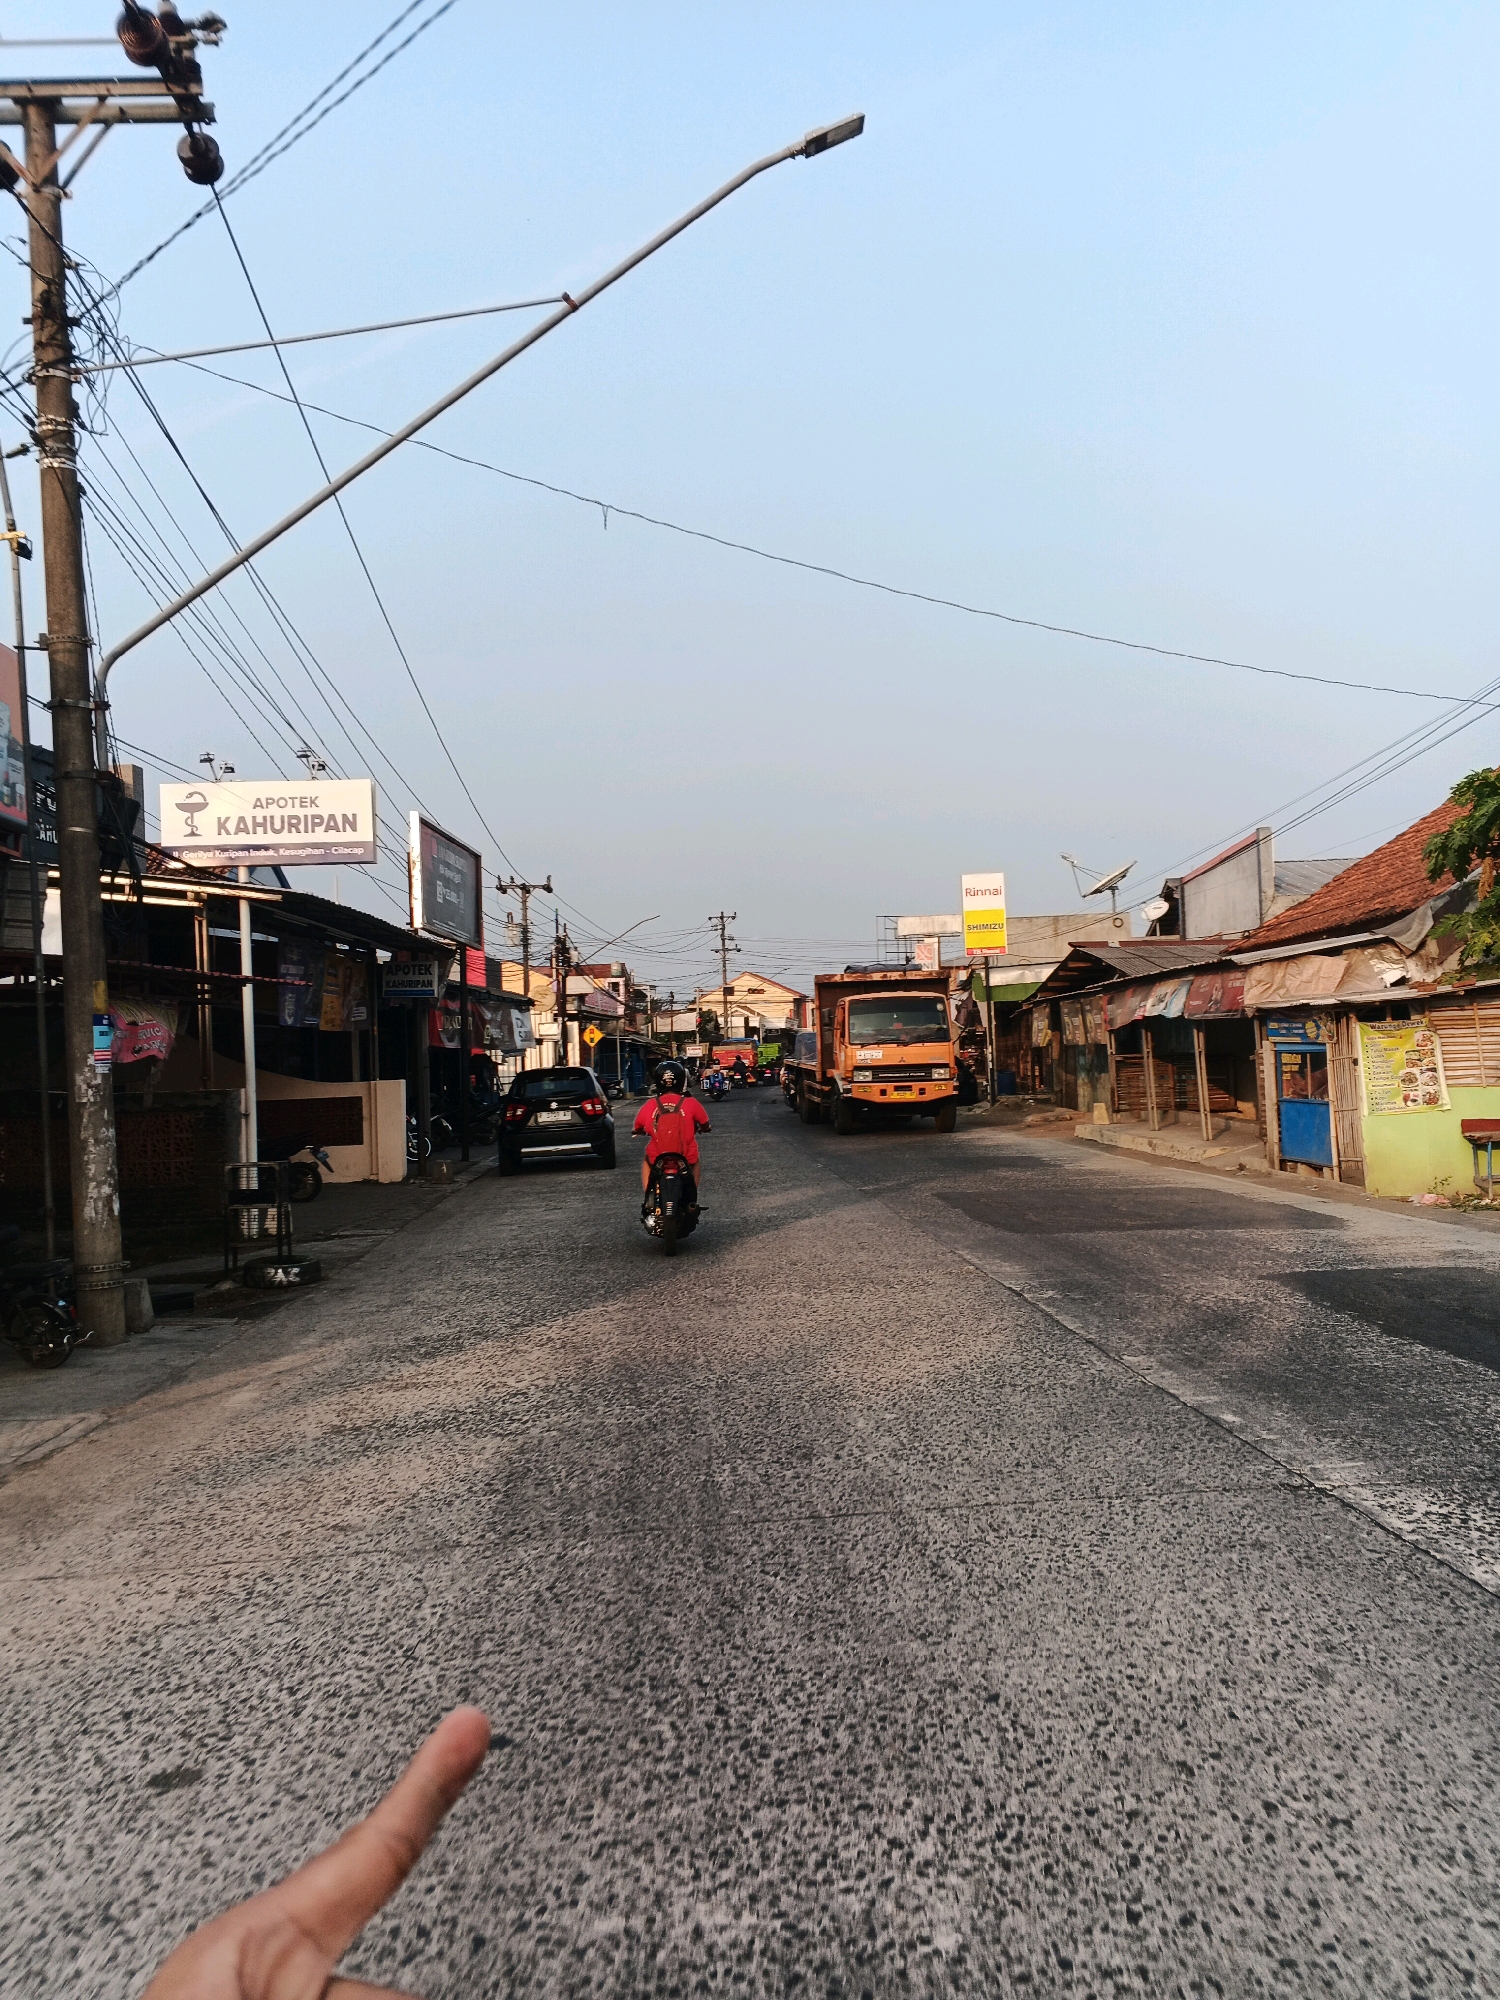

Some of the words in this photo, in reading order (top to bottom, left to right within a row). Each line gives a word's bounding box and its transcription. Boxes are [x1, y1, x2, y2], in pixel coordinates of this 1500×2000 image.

[253, 796, 320, 810] APOTEK
[217, 813, 358, 836] KAHURIPAN
[279, 847, 325, 859] Kesugihan
[331, 846, 365, 857] Cilacap
[965, 886, 1002, 897] Rinnai
[967, 922, 1004, 931] SHIMIZU
[386, 964, 433, 976] APOTEK
[385, 979, 433, 989] KAHURIPAN
